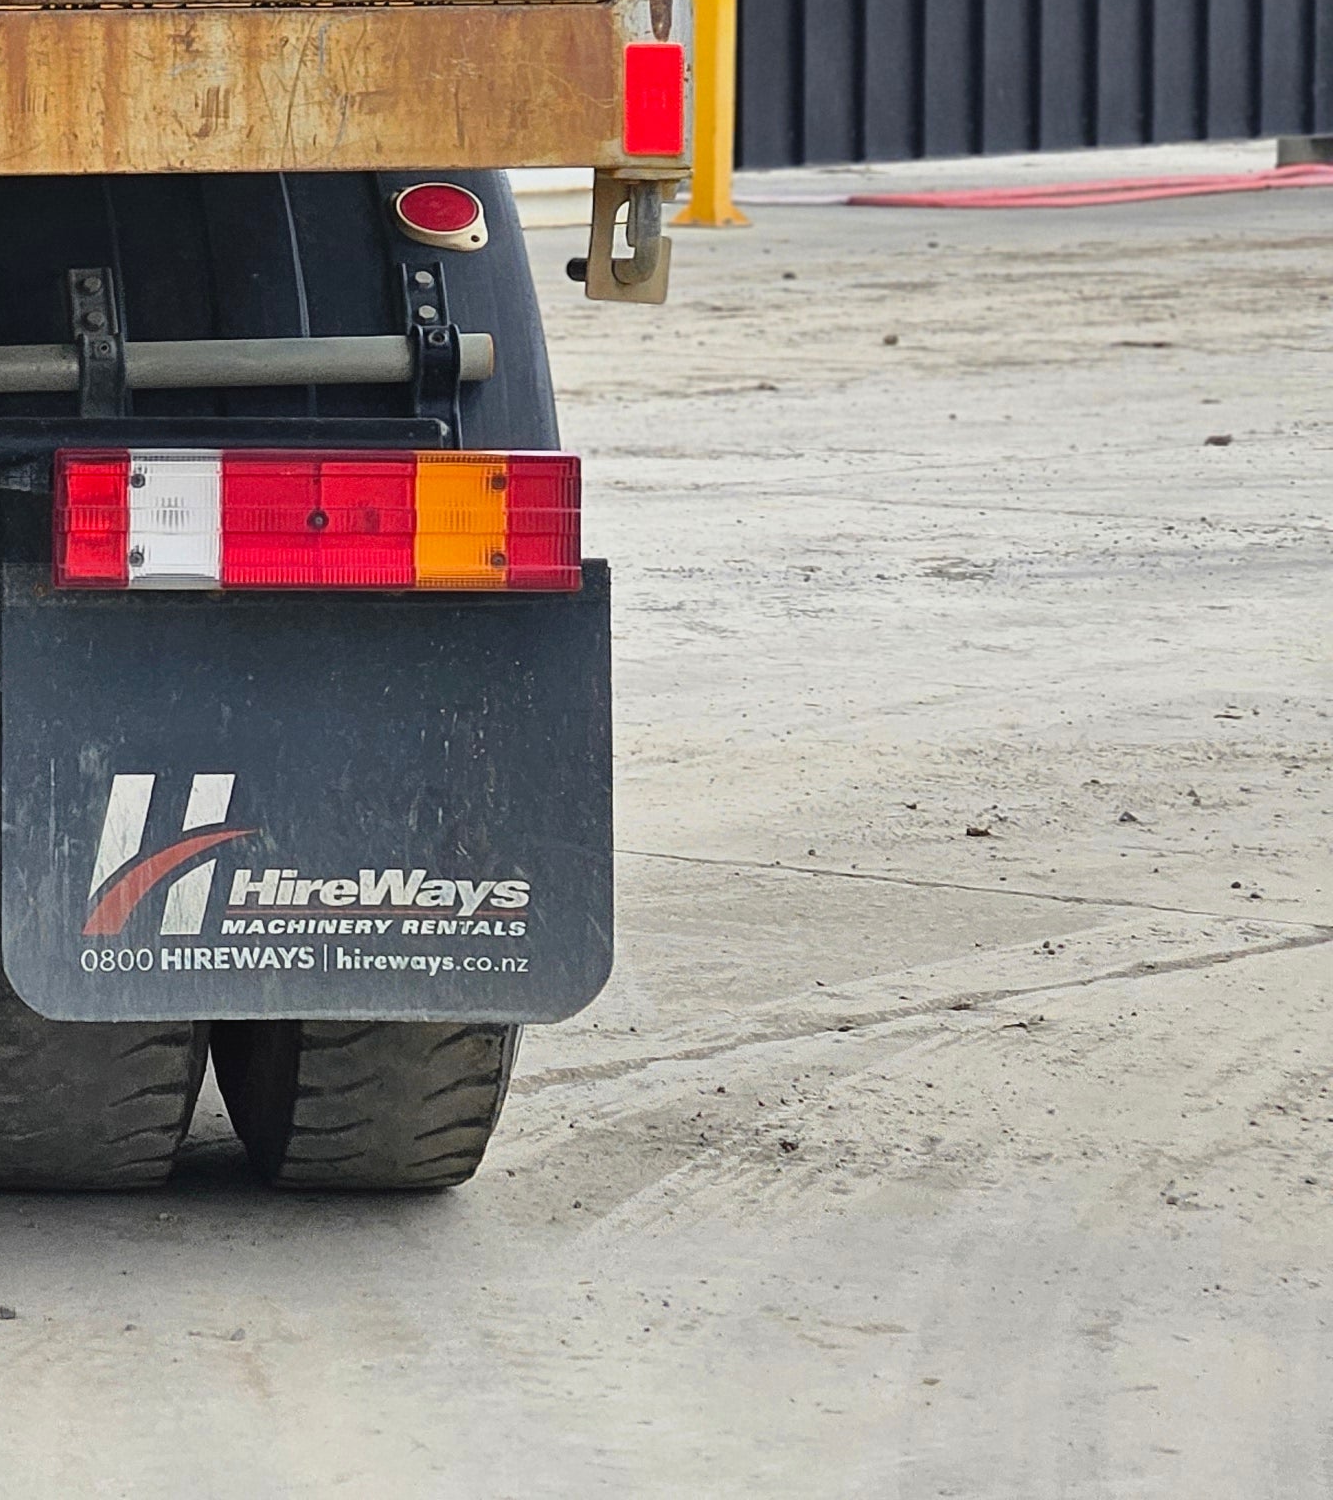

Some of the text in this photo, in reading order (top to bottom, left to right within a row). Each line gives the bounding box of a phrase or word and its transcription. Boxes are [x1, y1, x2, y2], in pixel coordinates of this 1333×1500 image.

[228, 869, 530, 916] HireWays
[221, 919, 527, 936] MACHINERY RENTALS
[80, 947, 530, 976] 0800 HIREWAYS hireways.co.nz
